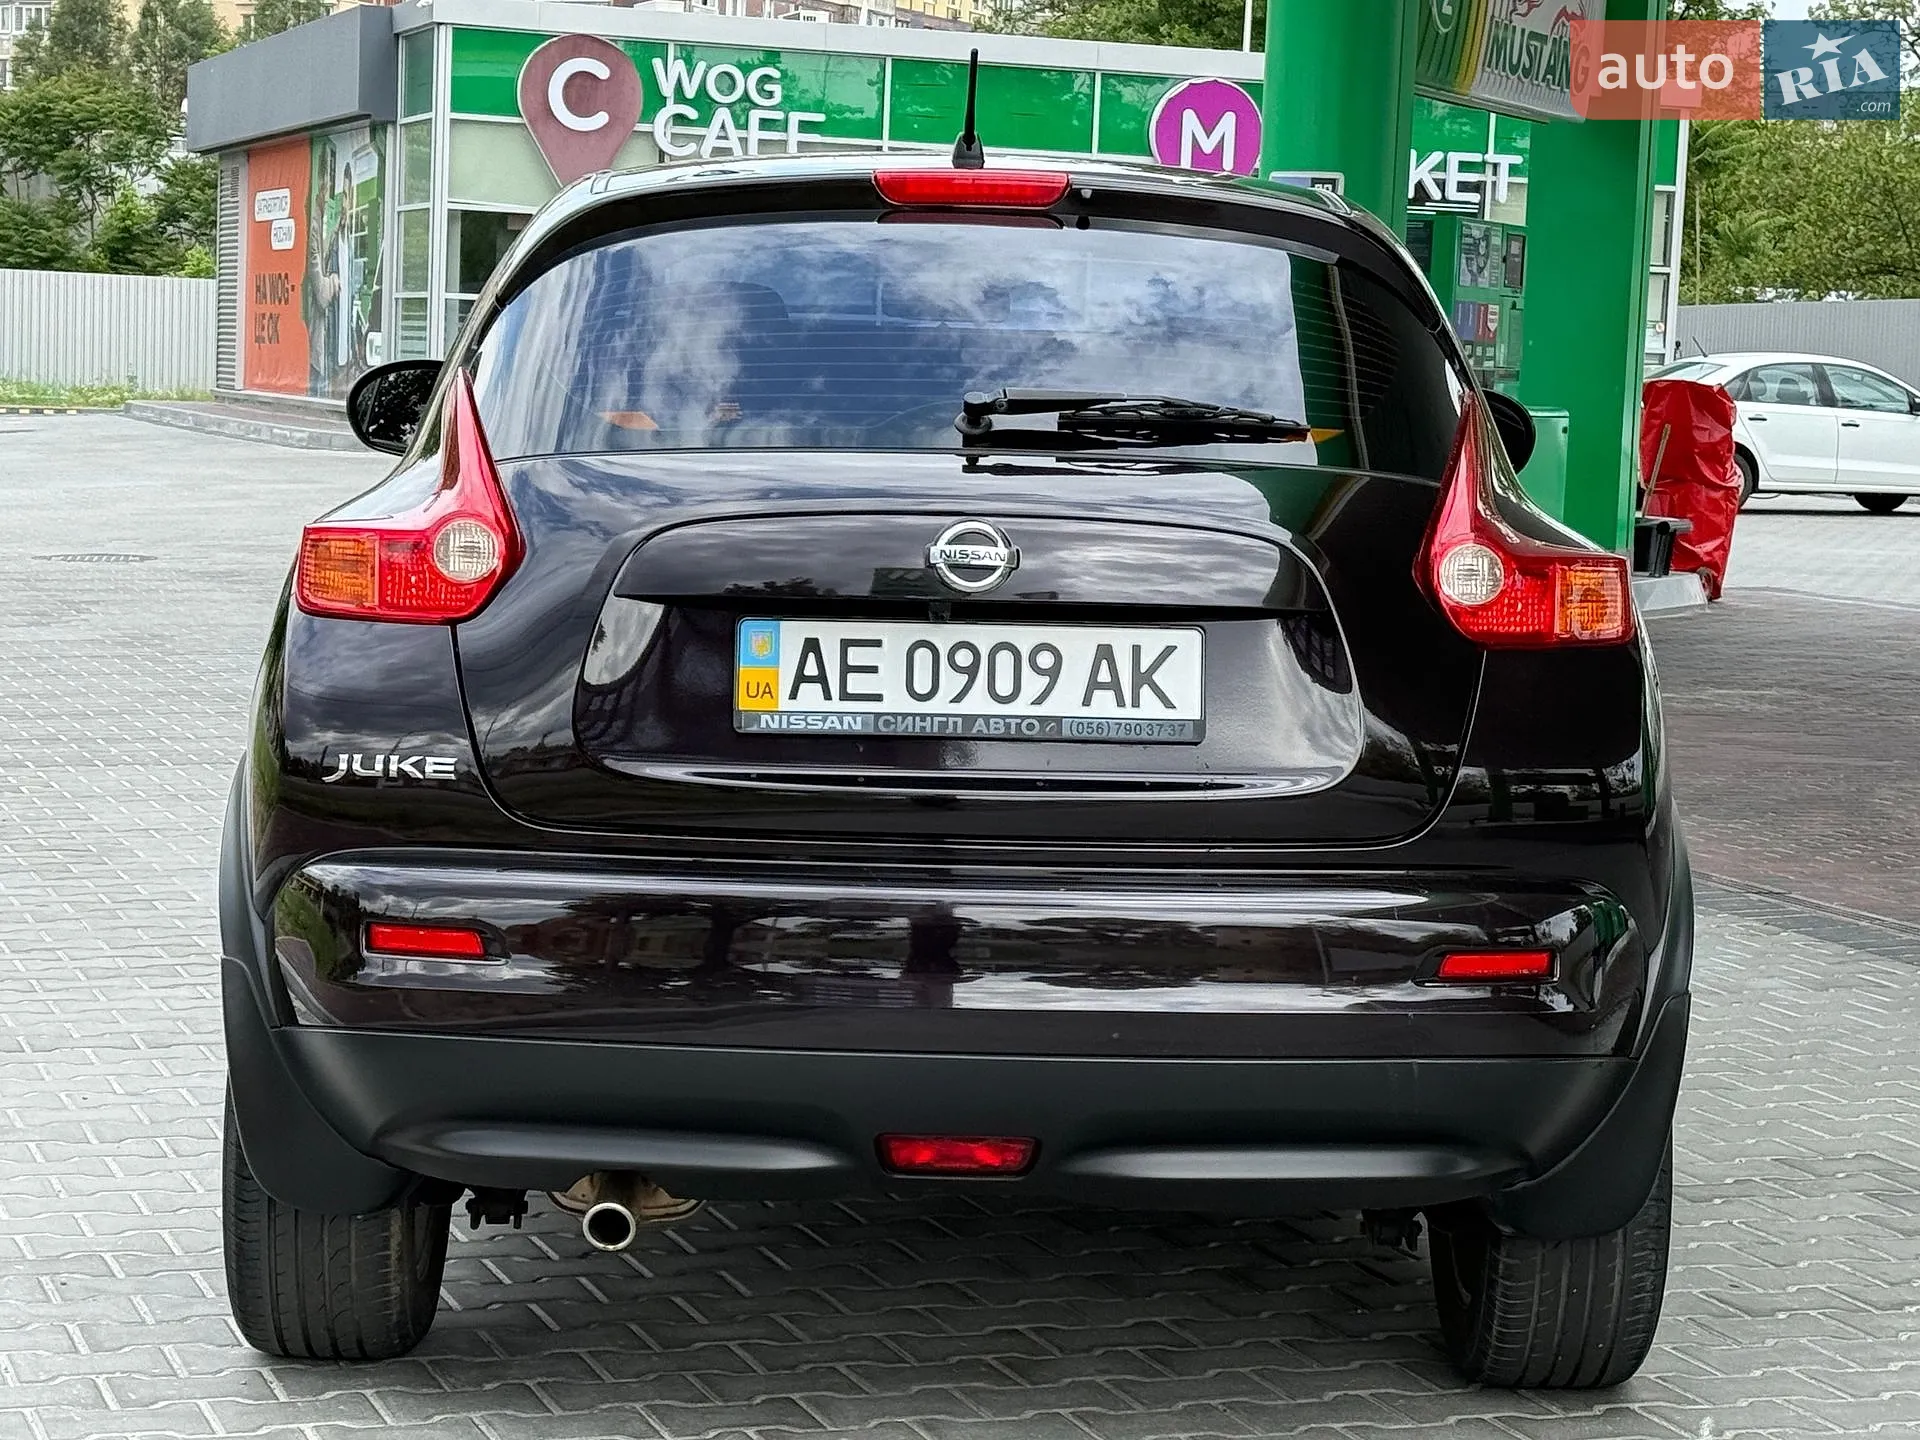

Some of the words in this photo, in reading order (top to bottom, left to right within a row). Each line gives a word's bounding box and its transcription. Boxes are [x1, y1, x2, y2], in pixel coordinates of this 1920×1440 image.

[1486, 18, 1591, 95] MUSTANG
[548, 57, 611, 132] C
[651, 57, 782, 107] WOG
[1180, 108, 1237, 171] M
[940, 549, 1006, 562] NISSAN
[745, 681, 774, 700] UA
[788, 637, 884, 702] AE
[905, 639, 1063, 706] 0909
[1081, 643, 1178, 709] AK
[759, 714, 863, 731] NISSAN
[877, 716, 963, 734] СИНГЛ
[971, 717, 1041, 736] АВТО
[321, 753, 458, 783] JUKE
